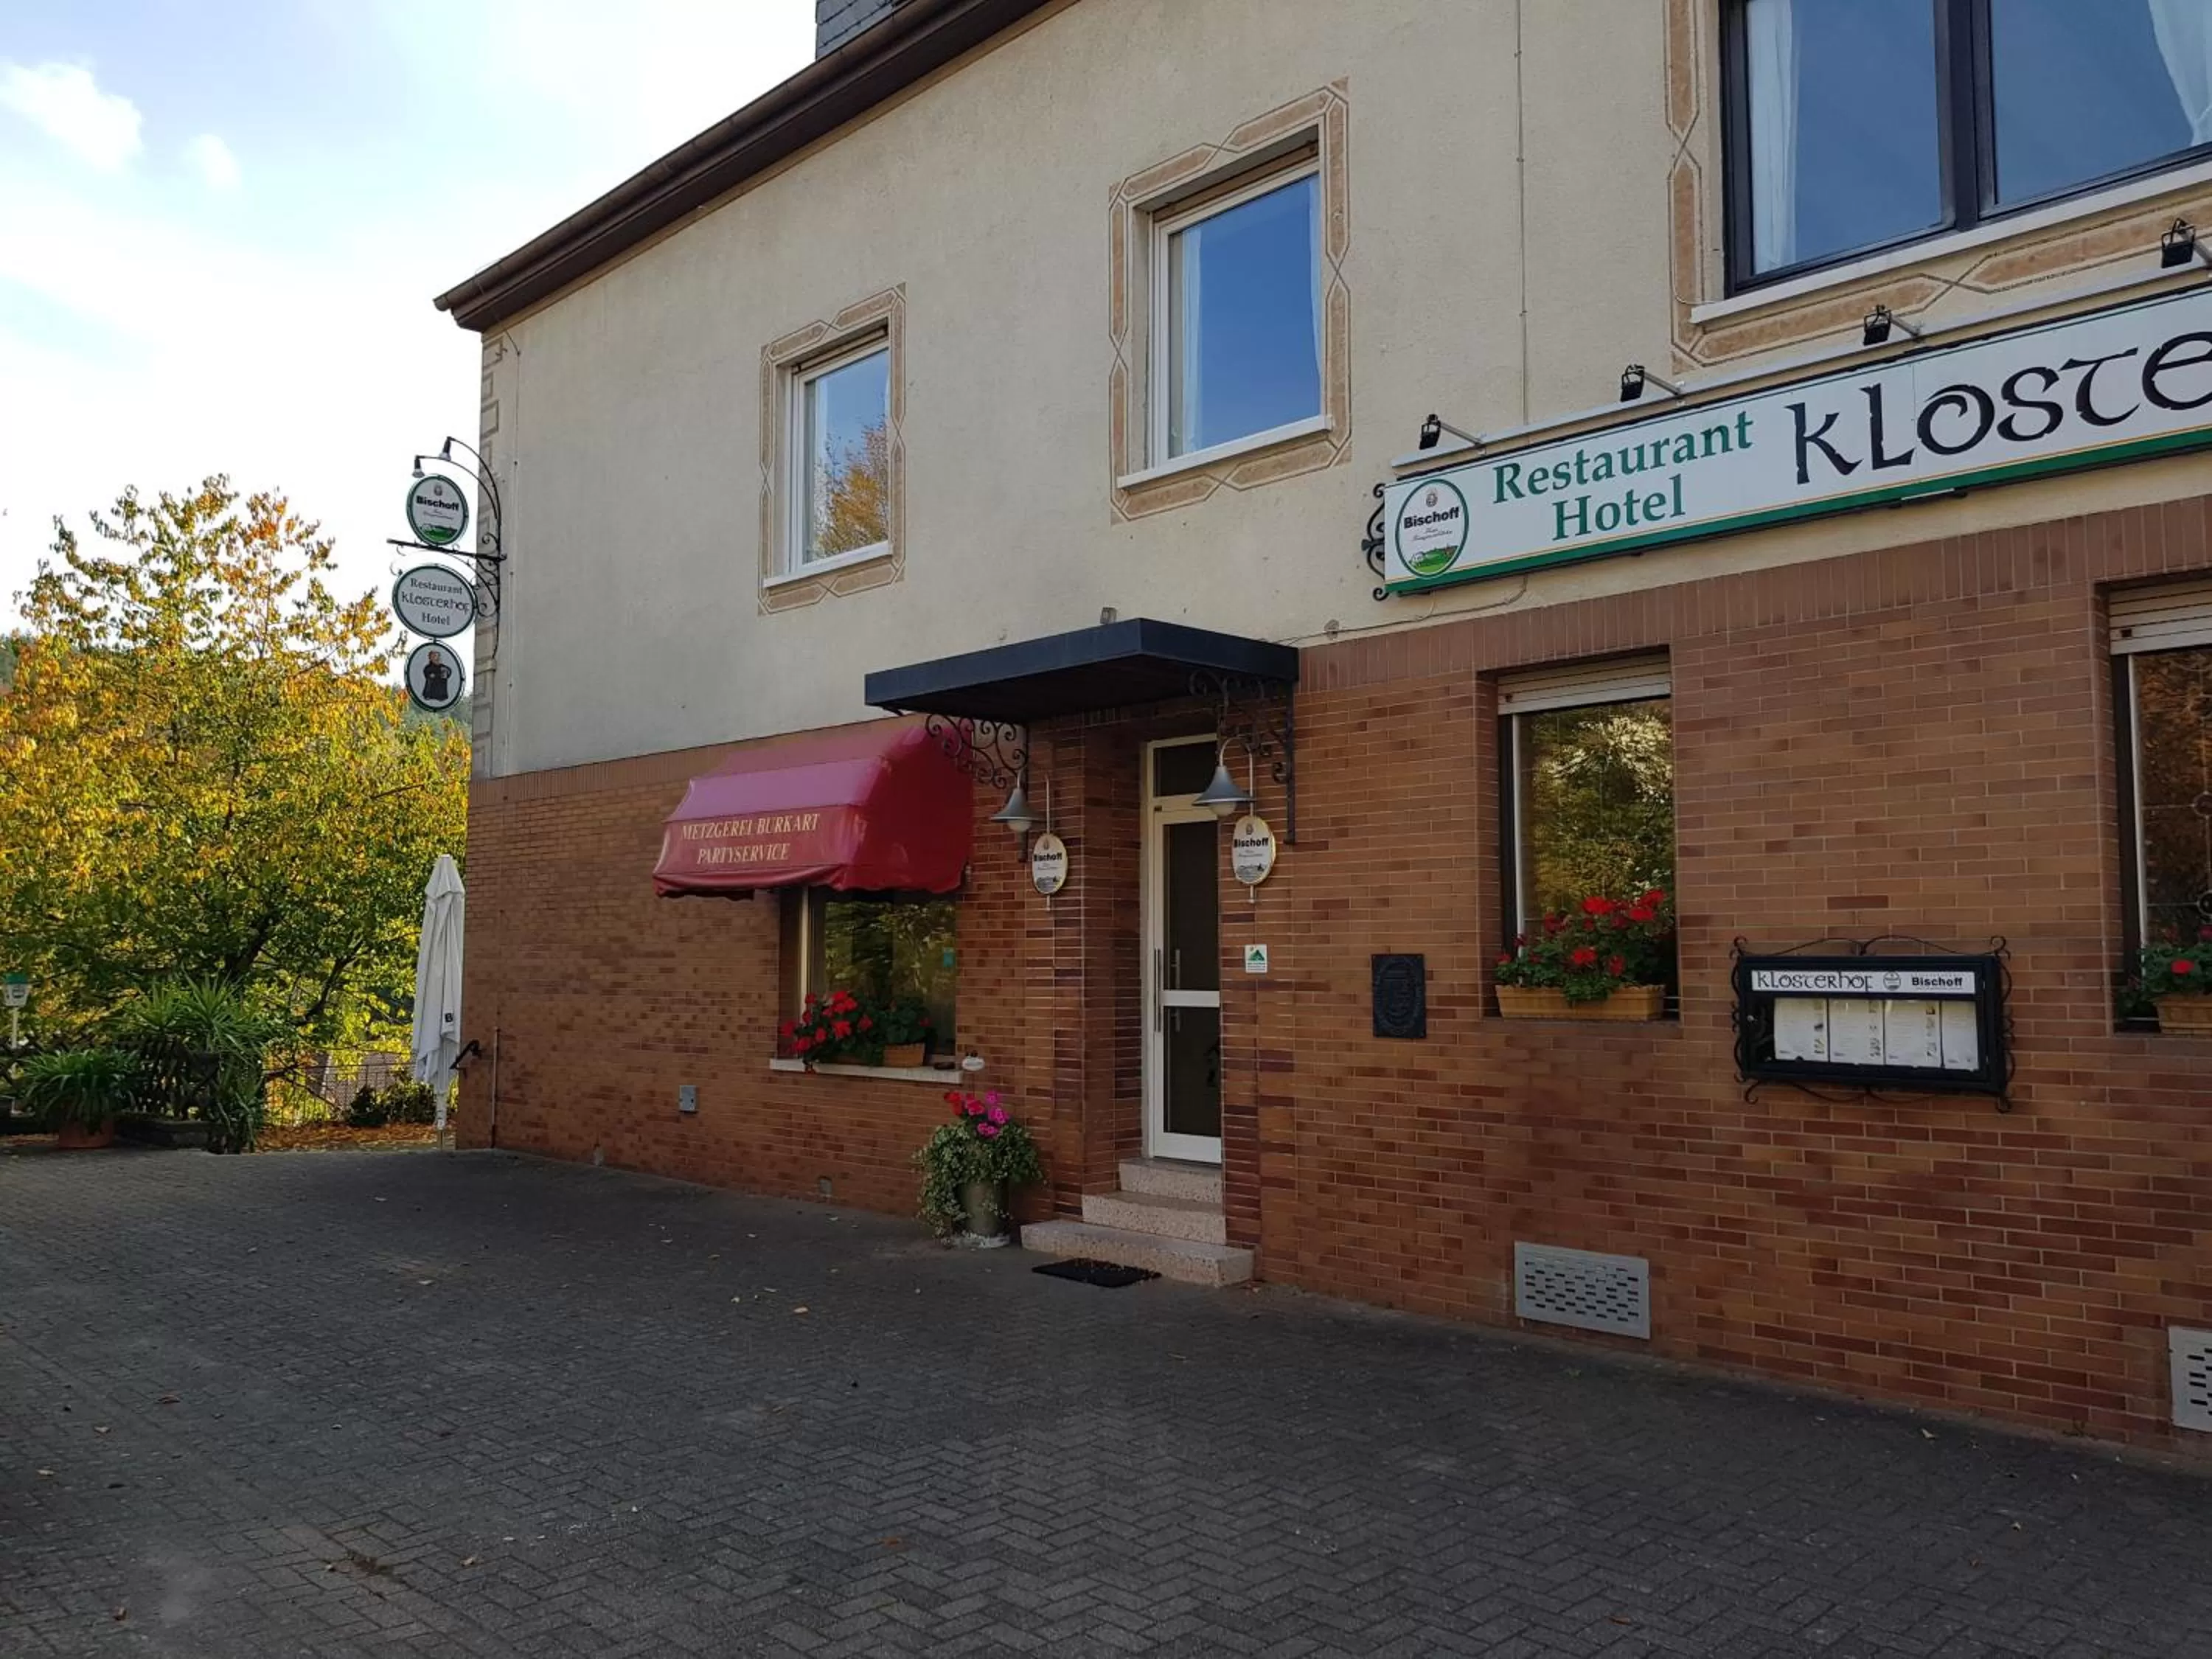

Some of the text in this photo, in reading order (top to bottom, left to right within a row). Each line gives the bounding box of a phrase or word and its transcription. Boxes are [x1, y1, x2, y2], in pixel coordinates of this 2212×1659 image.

[1493, 411, 1754, 504] Restaurant
[417, 495, 459, 510] Bischoff
[1552, 473, 1686, 540] Hotel
[1404, 507, 1459, 529] Bischoff
[410, 578, 462, 594] Restaurant
[422, 612, 450, 625] Hotel
[680, 813, 821, 841] METZGEREI BURKART
[1233, 837, 1269, 848] Bischoff
[696, 843, 791, 865] PARTYSERVICE
[1912, 976, 1963, 987] Bischoff
